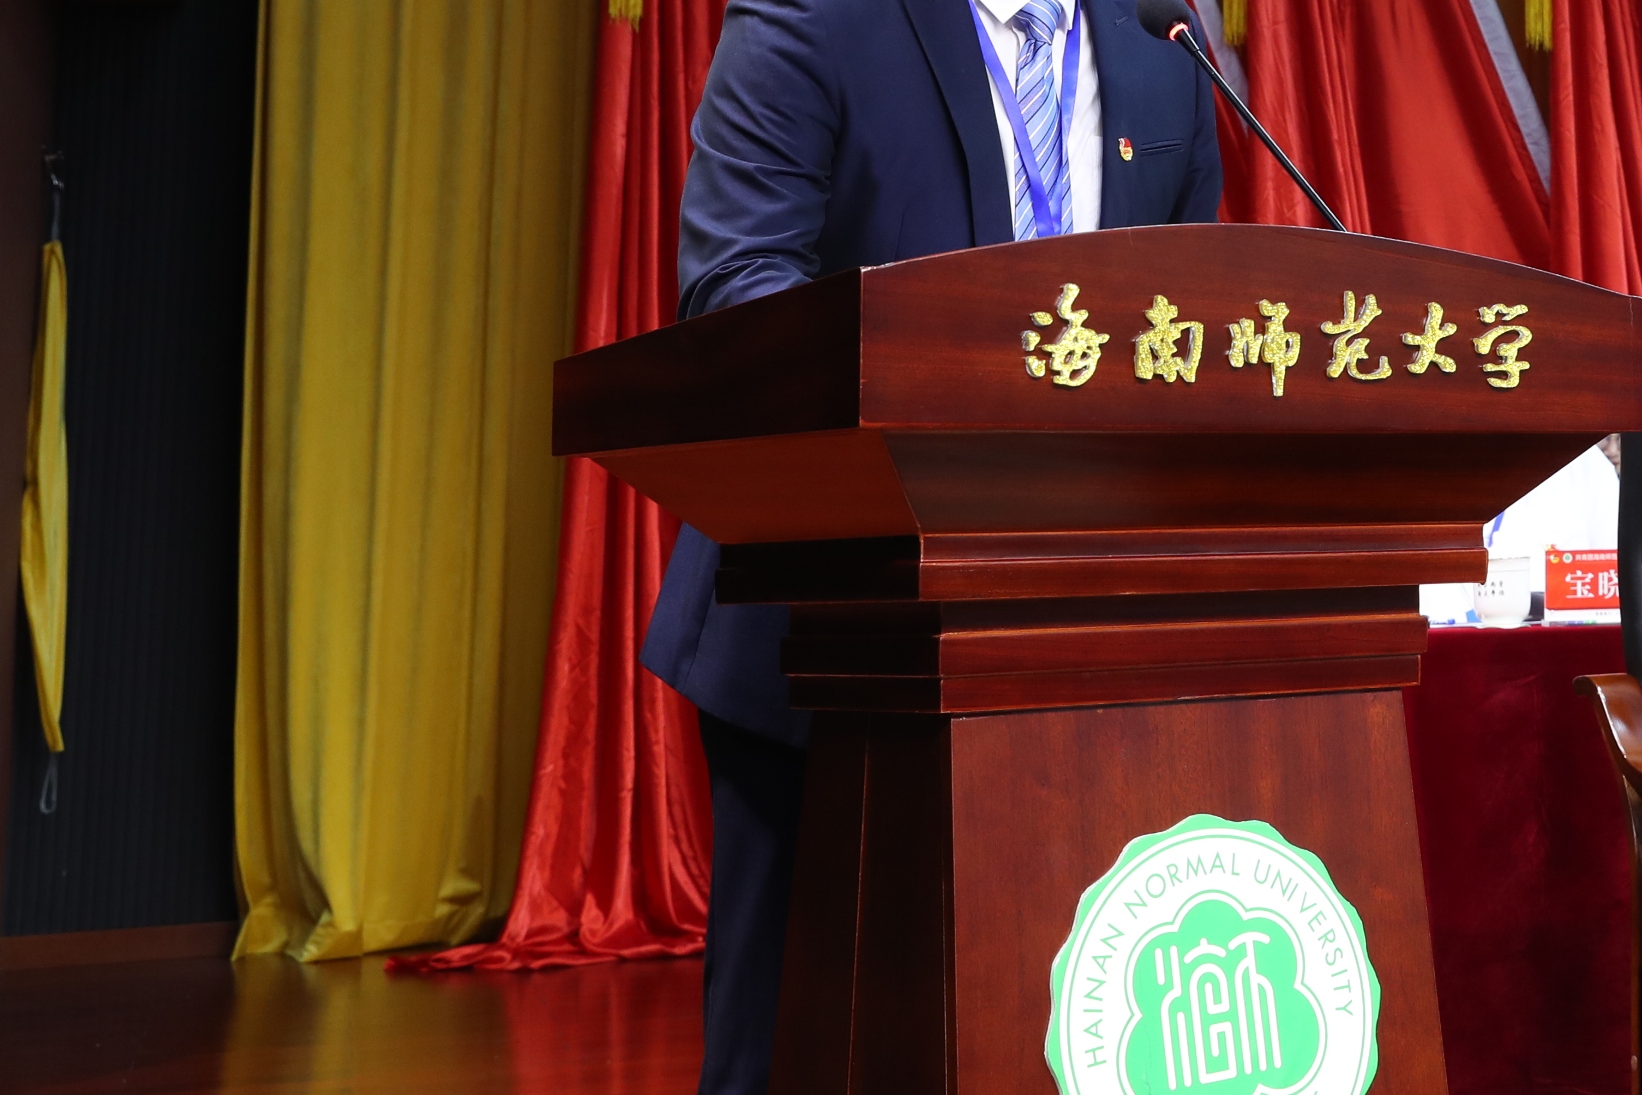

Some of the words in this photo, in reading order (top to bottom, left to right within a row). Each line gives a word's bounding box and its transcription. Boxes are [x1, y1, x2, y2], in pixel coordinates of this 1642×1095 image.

[1021, 283, 1534, 398] 海南师范大学
[1083, 923, 1126, 1068] HAINAN
[1123, 851, 1241, 919] NORMAL
[1253, 859, 1354, 1016] UNIVERSITY
